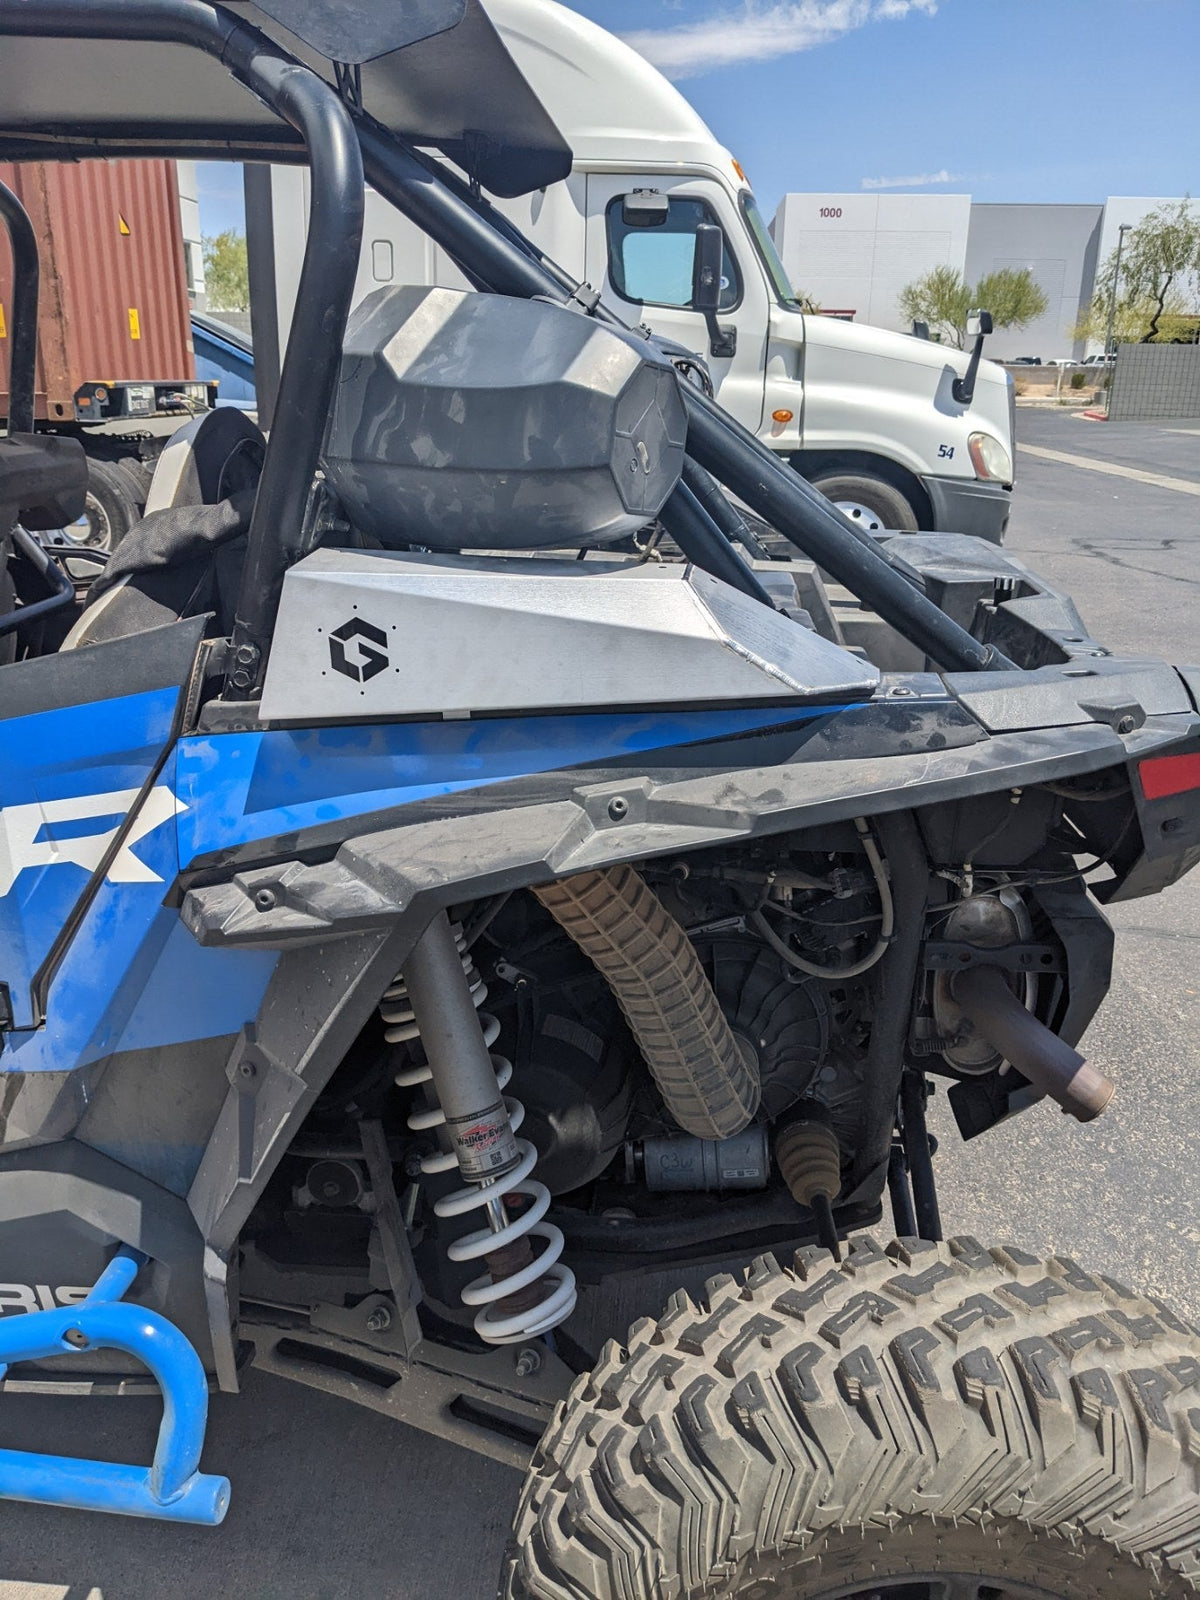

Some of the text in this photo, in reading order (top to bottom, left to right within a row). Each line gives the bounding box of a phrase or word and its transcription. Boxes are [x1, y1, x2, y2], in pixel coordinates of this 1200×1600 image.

[819, 207, 843, 218] 1000
[937, 444, 955, 459] 54
[456, 1131, 488, 1146] Walker
